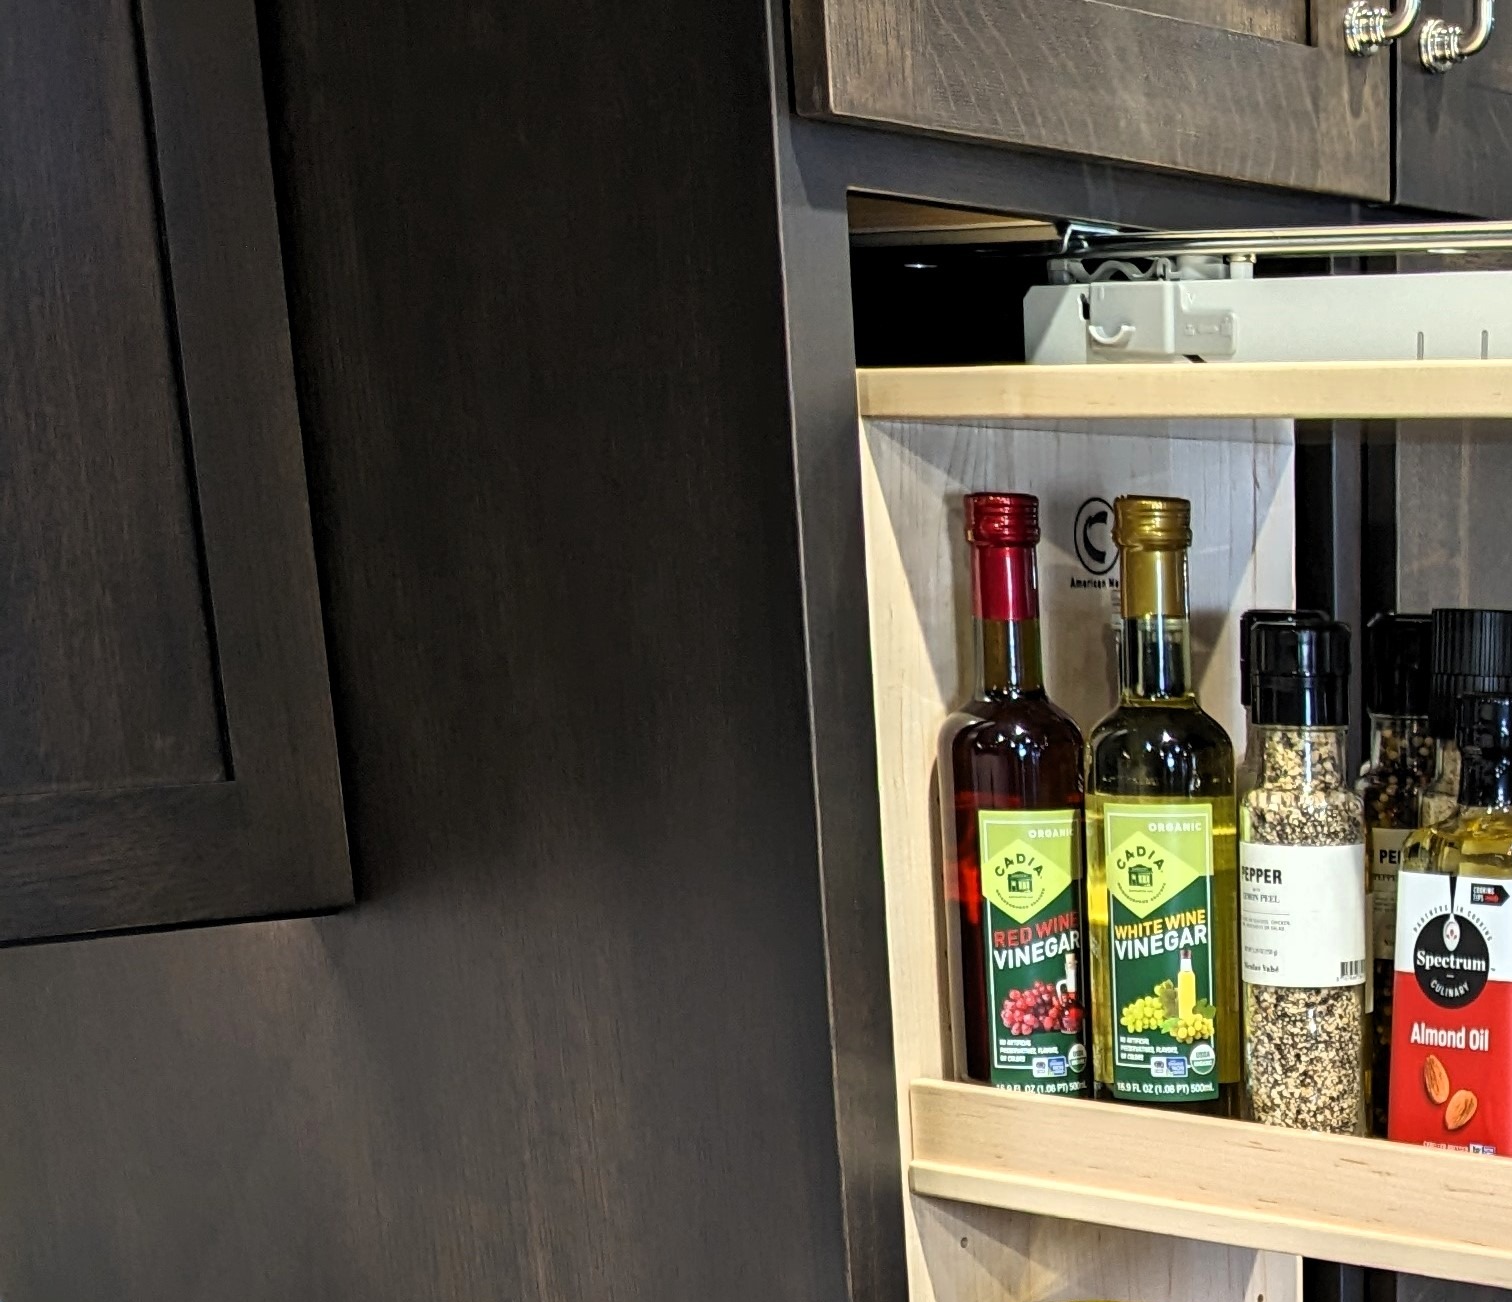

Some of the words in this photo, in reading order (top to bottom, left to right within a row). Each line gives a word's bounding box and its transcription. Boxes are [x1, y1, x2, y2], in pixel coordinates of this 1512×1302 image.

[1028, 828, 1074, 839] ORGANIC
[1148, 822, 1202, 832] ORGANIC
[994, 853, 1044, 877] CADIA
[1116, 846, 1165, 870] CADIA
[993, 926, 1032, 948] RED
[1036, 911, 1079, 938] WINE
[1114, 918, 1164, 940] WHITE
[1165, 909, 1206, 932] WINE
[993, 930, 1080, 970] VINEGAR
[1115, 925, 1207, 961] VINEGAR
[1416, 950, 1486, 972] Spectrum
[1430, 979, 1470, 998] CULINARY
[1410, 1021, 1465, 1049] Almond
[1469, 1027, 1489, 1051] Oil
[1143, 1083, 1154, 1093] OZ
